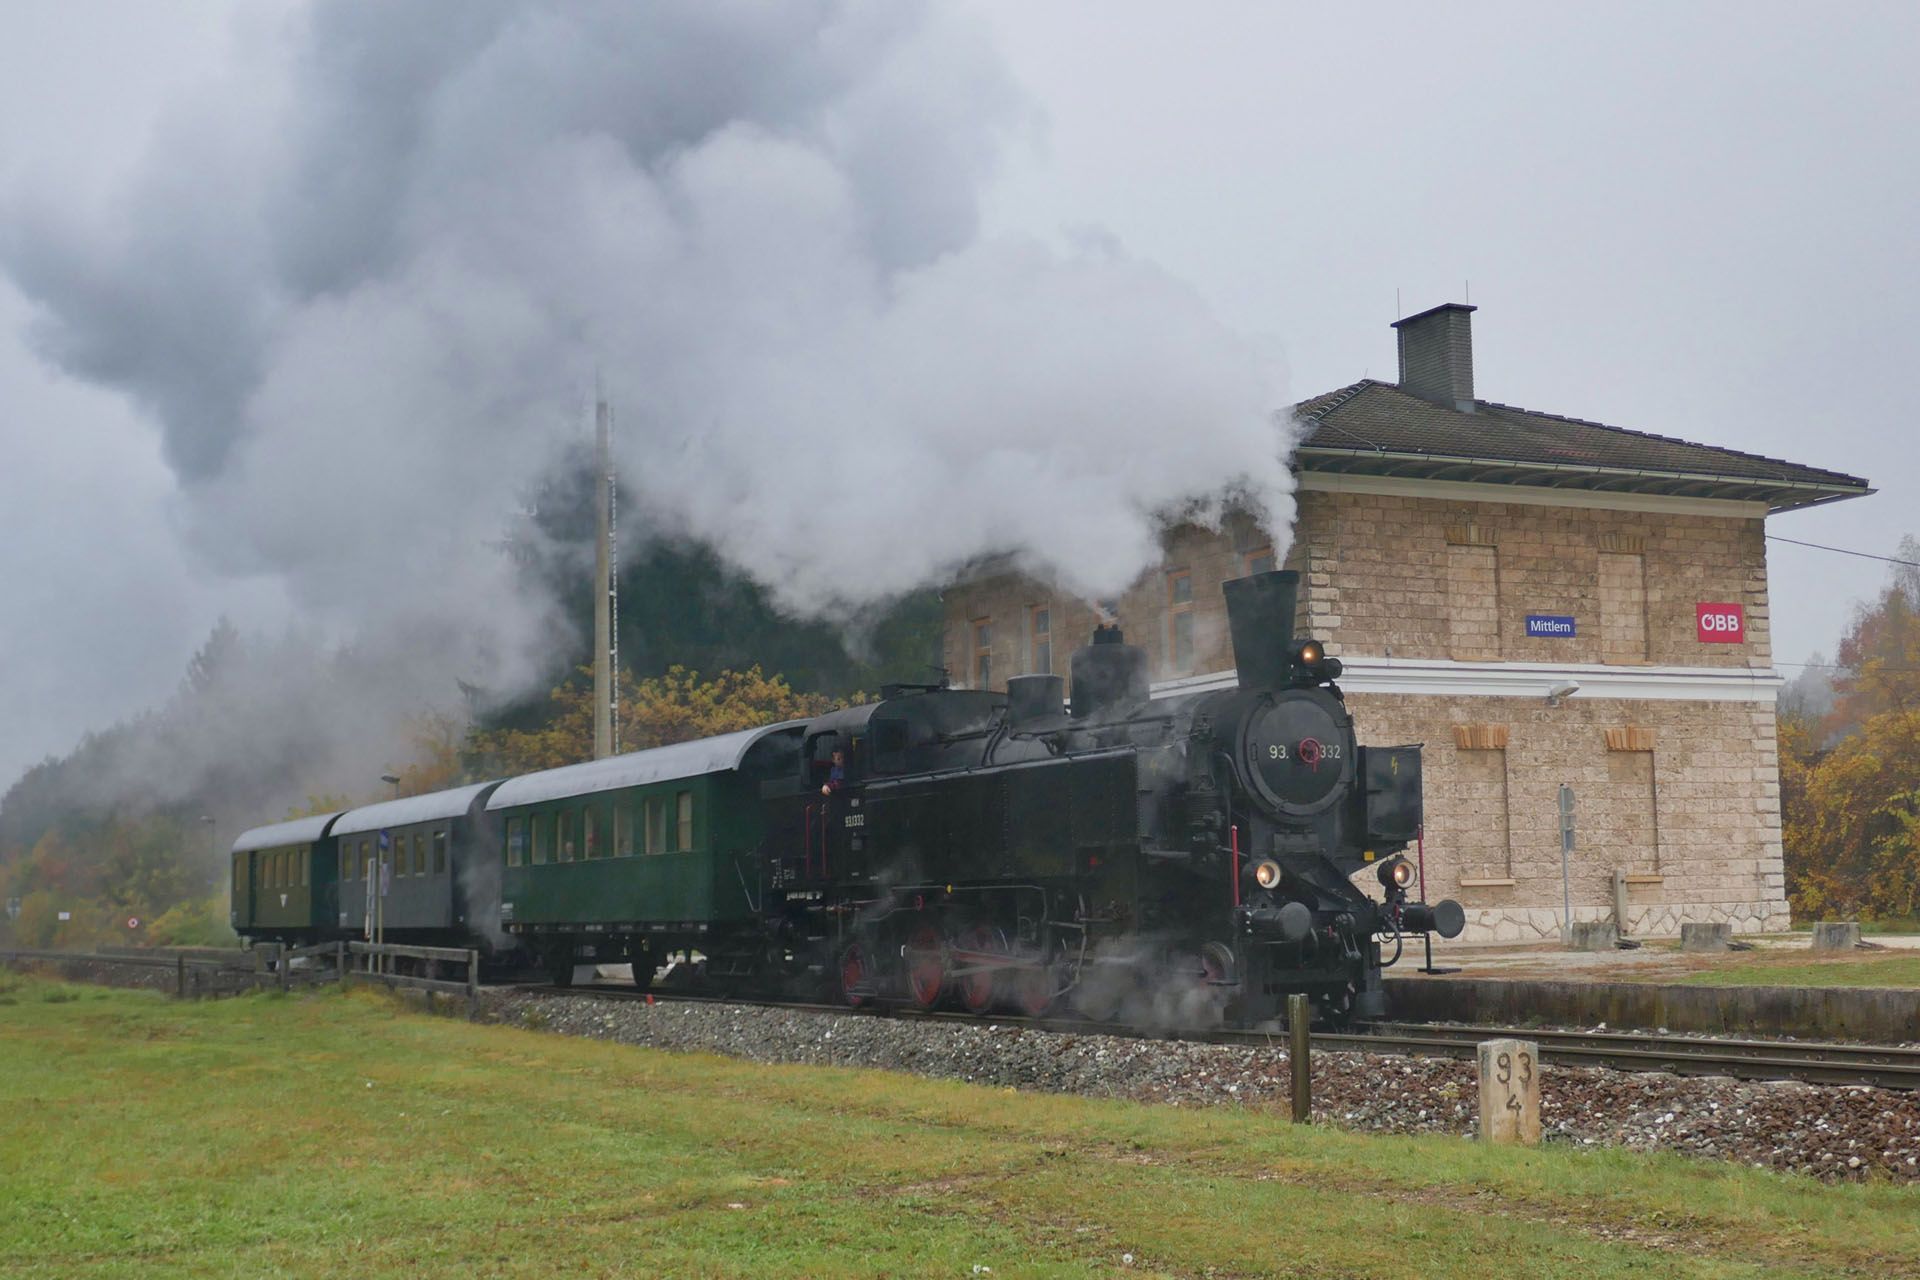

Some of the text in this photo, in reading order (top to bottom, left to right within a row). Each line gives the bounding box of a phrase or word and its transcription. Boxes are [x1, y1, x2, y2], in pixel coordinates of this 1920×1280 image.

[1530, 619, 1571, 633] Mittlern
[1701, 613, 1739, 632] ÖBB
[1268, 744, 1289, 759] 93.
[1496, 1051, 1532, 1084] 93
[1506, 1093, 1523, 1117] 4
